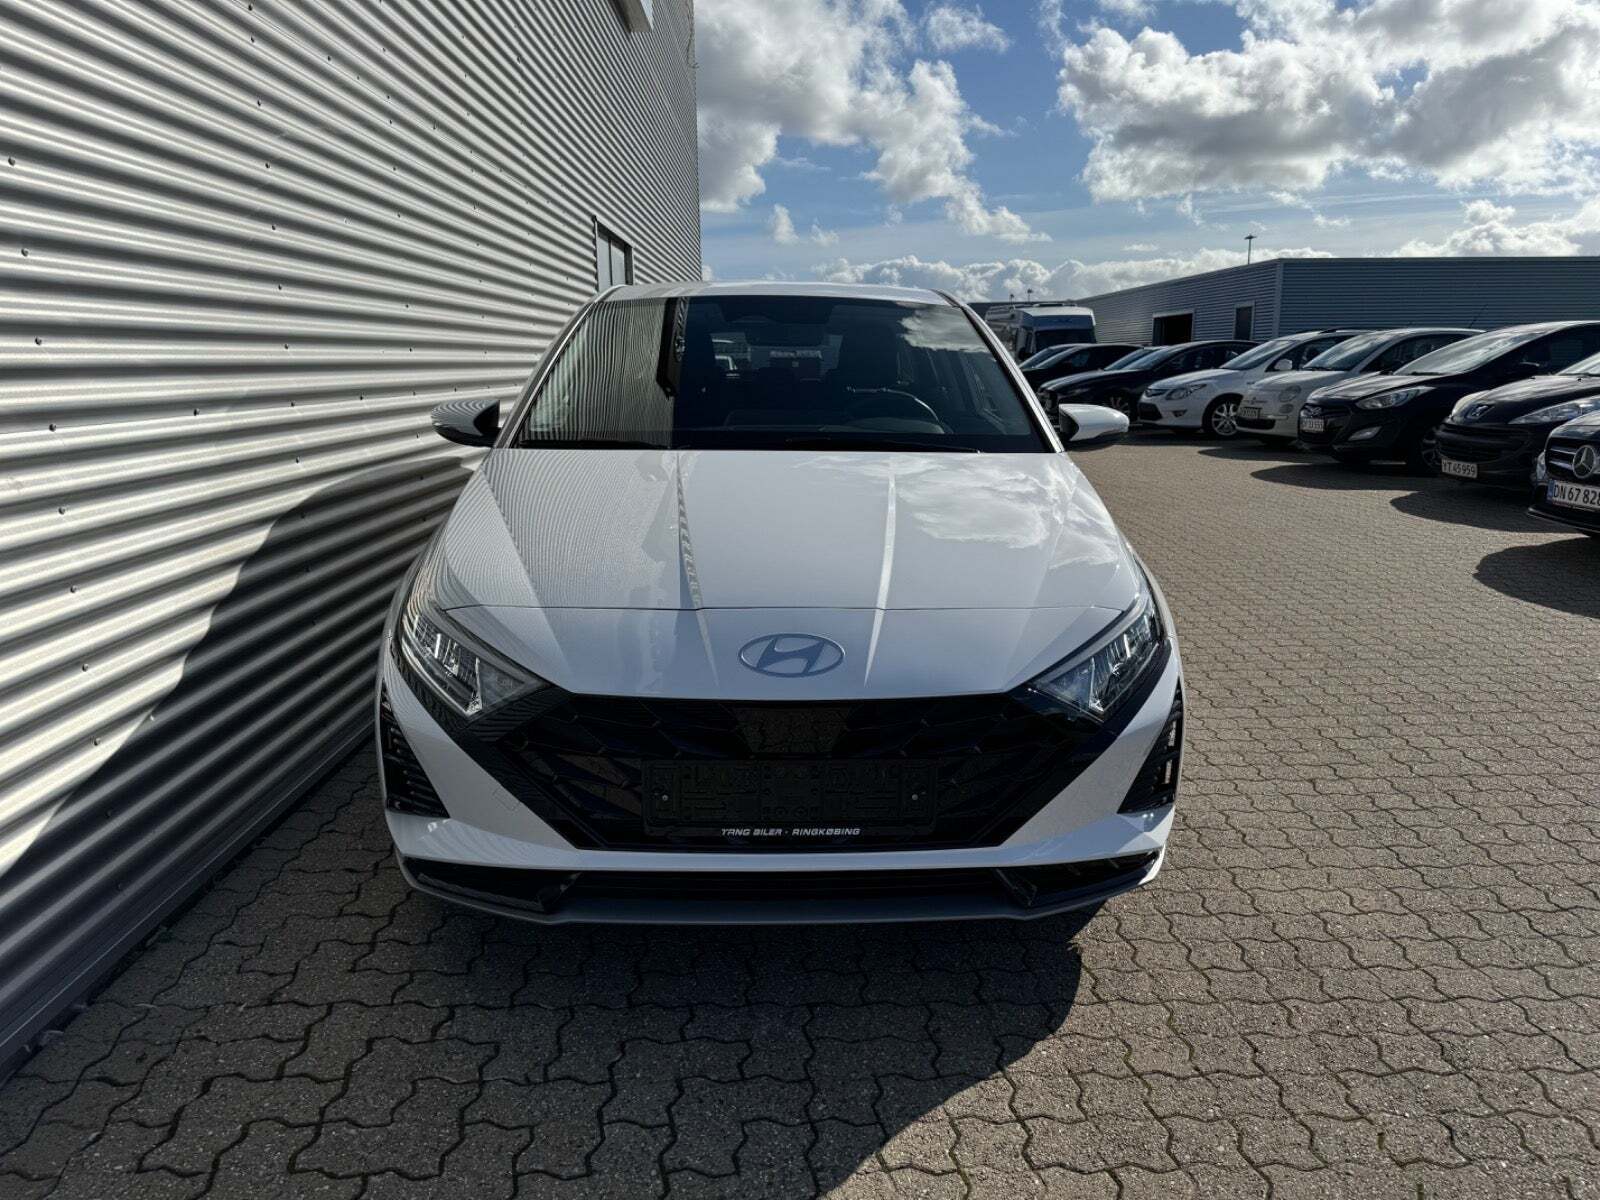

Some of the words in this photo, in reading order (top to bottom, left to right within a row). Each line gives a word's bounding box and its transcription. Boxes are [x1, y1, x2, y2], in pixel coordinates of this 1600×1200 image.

[1553, 484, 1566, 499] DN
[1568, 487, 1581, 502] 67
[753, 828, 783, 837] BILER
[792, 828, 861, 837] RINGKØBING
